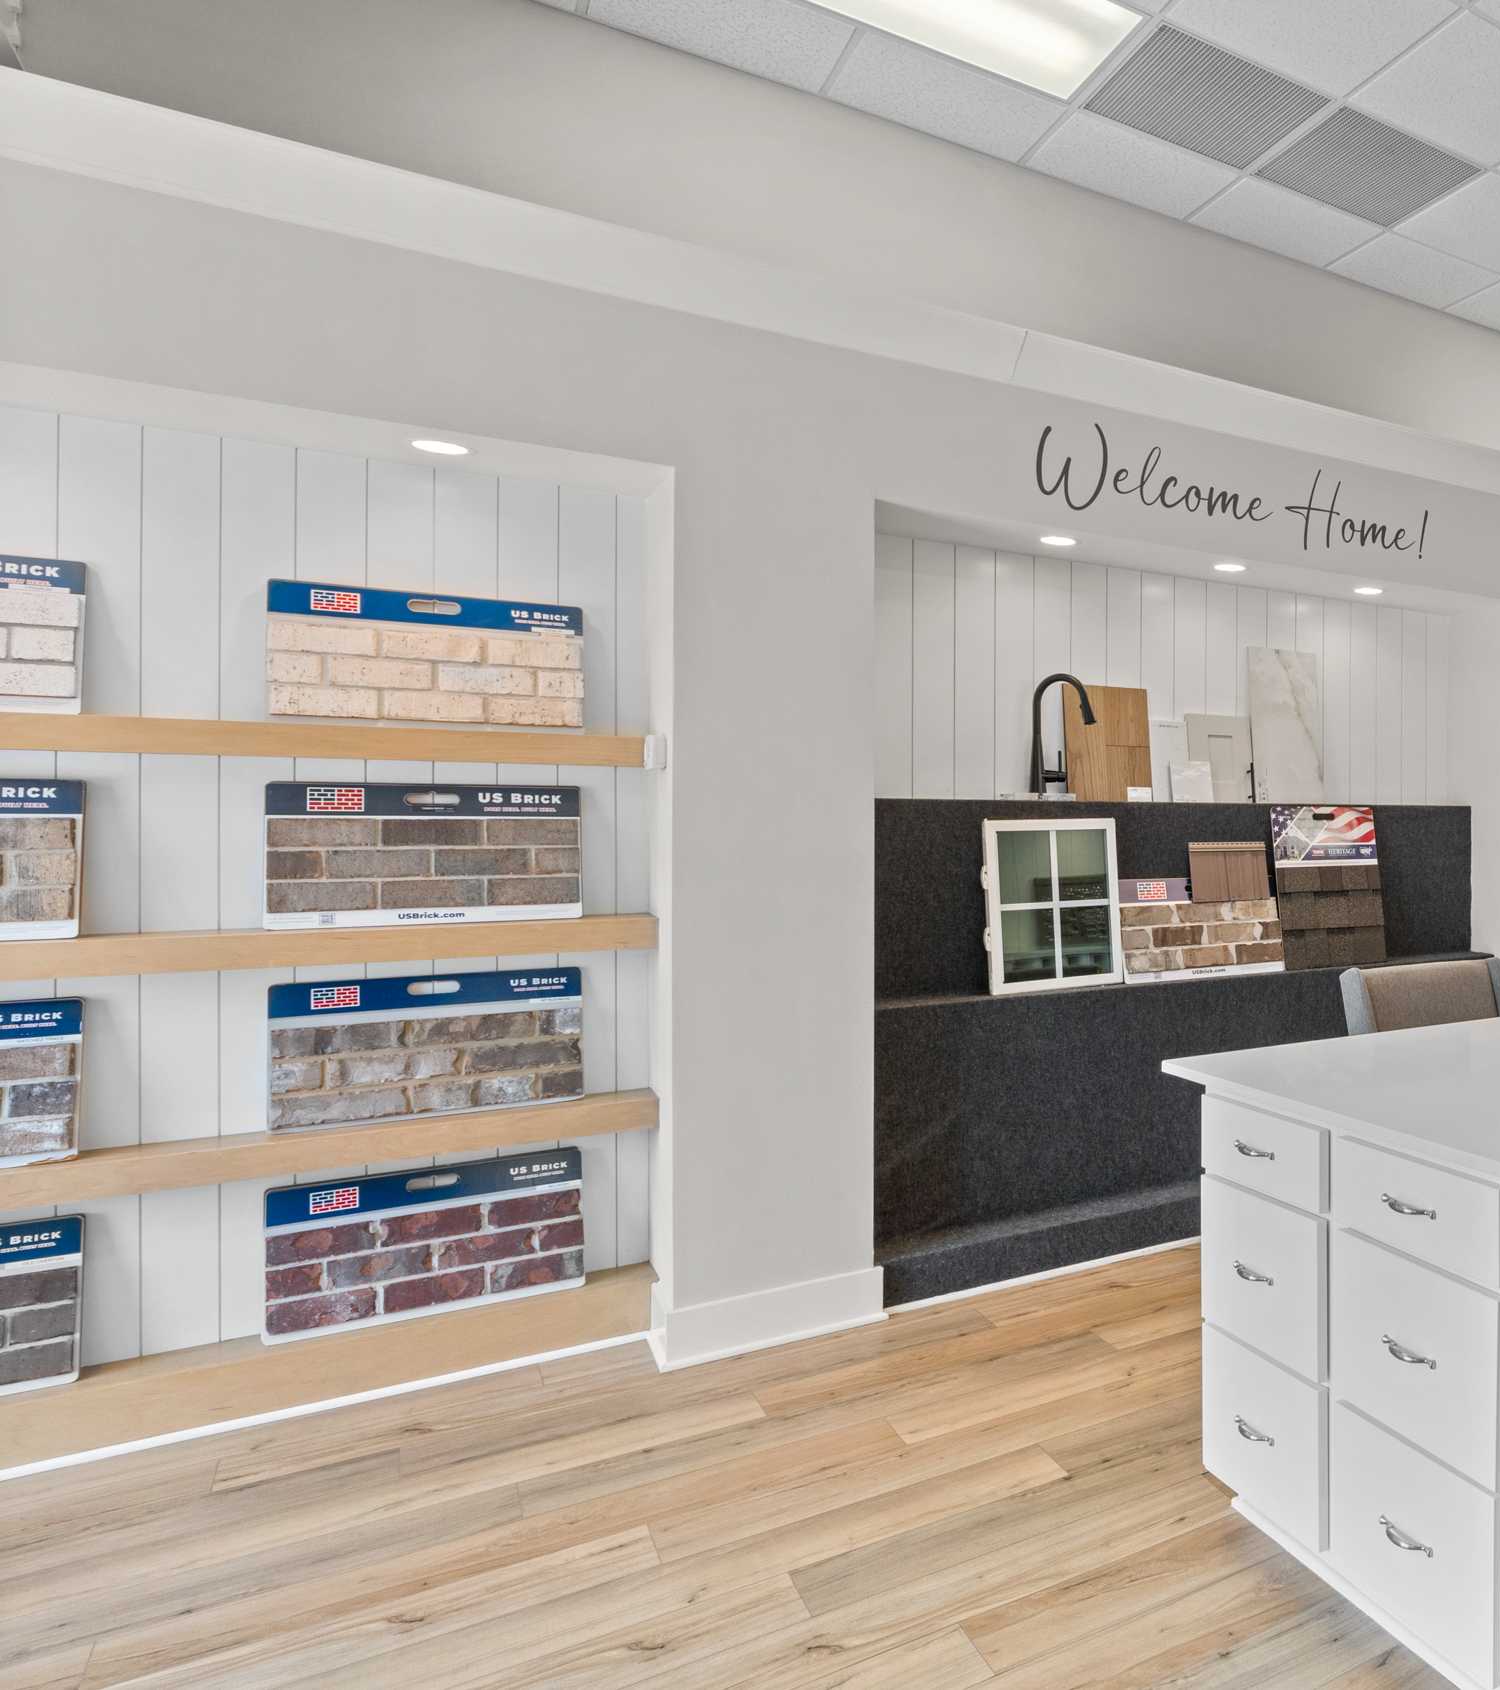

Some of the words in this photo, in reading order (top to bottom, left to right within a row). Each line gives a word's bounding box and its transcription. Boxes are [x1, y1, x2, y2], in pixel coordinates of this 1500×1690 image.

[1036, 423, 1274, 522] Welcome
[1284, 469, 1430, 560] Home!
[0, 561, 60, 577] RICK
[511, 609, 529, 618] US
[533, 611, 569, 622] BRICK
[0, 786, 57, 798] RICK
[478, 792, 503, 804] US
[510, 793, 562, 804] BRICK
[398, 911, 465, 920] USBrick.com
[510, 978, 528, 986] US
[532, 976, 568, 985] BRICK
[10, 1011, 63, 1022] BRICK
[510, 1166, 528, 1175] US
[532, 1161, 568, 1173] BRICK
[9, 1230, 62, 1245] BRICK
